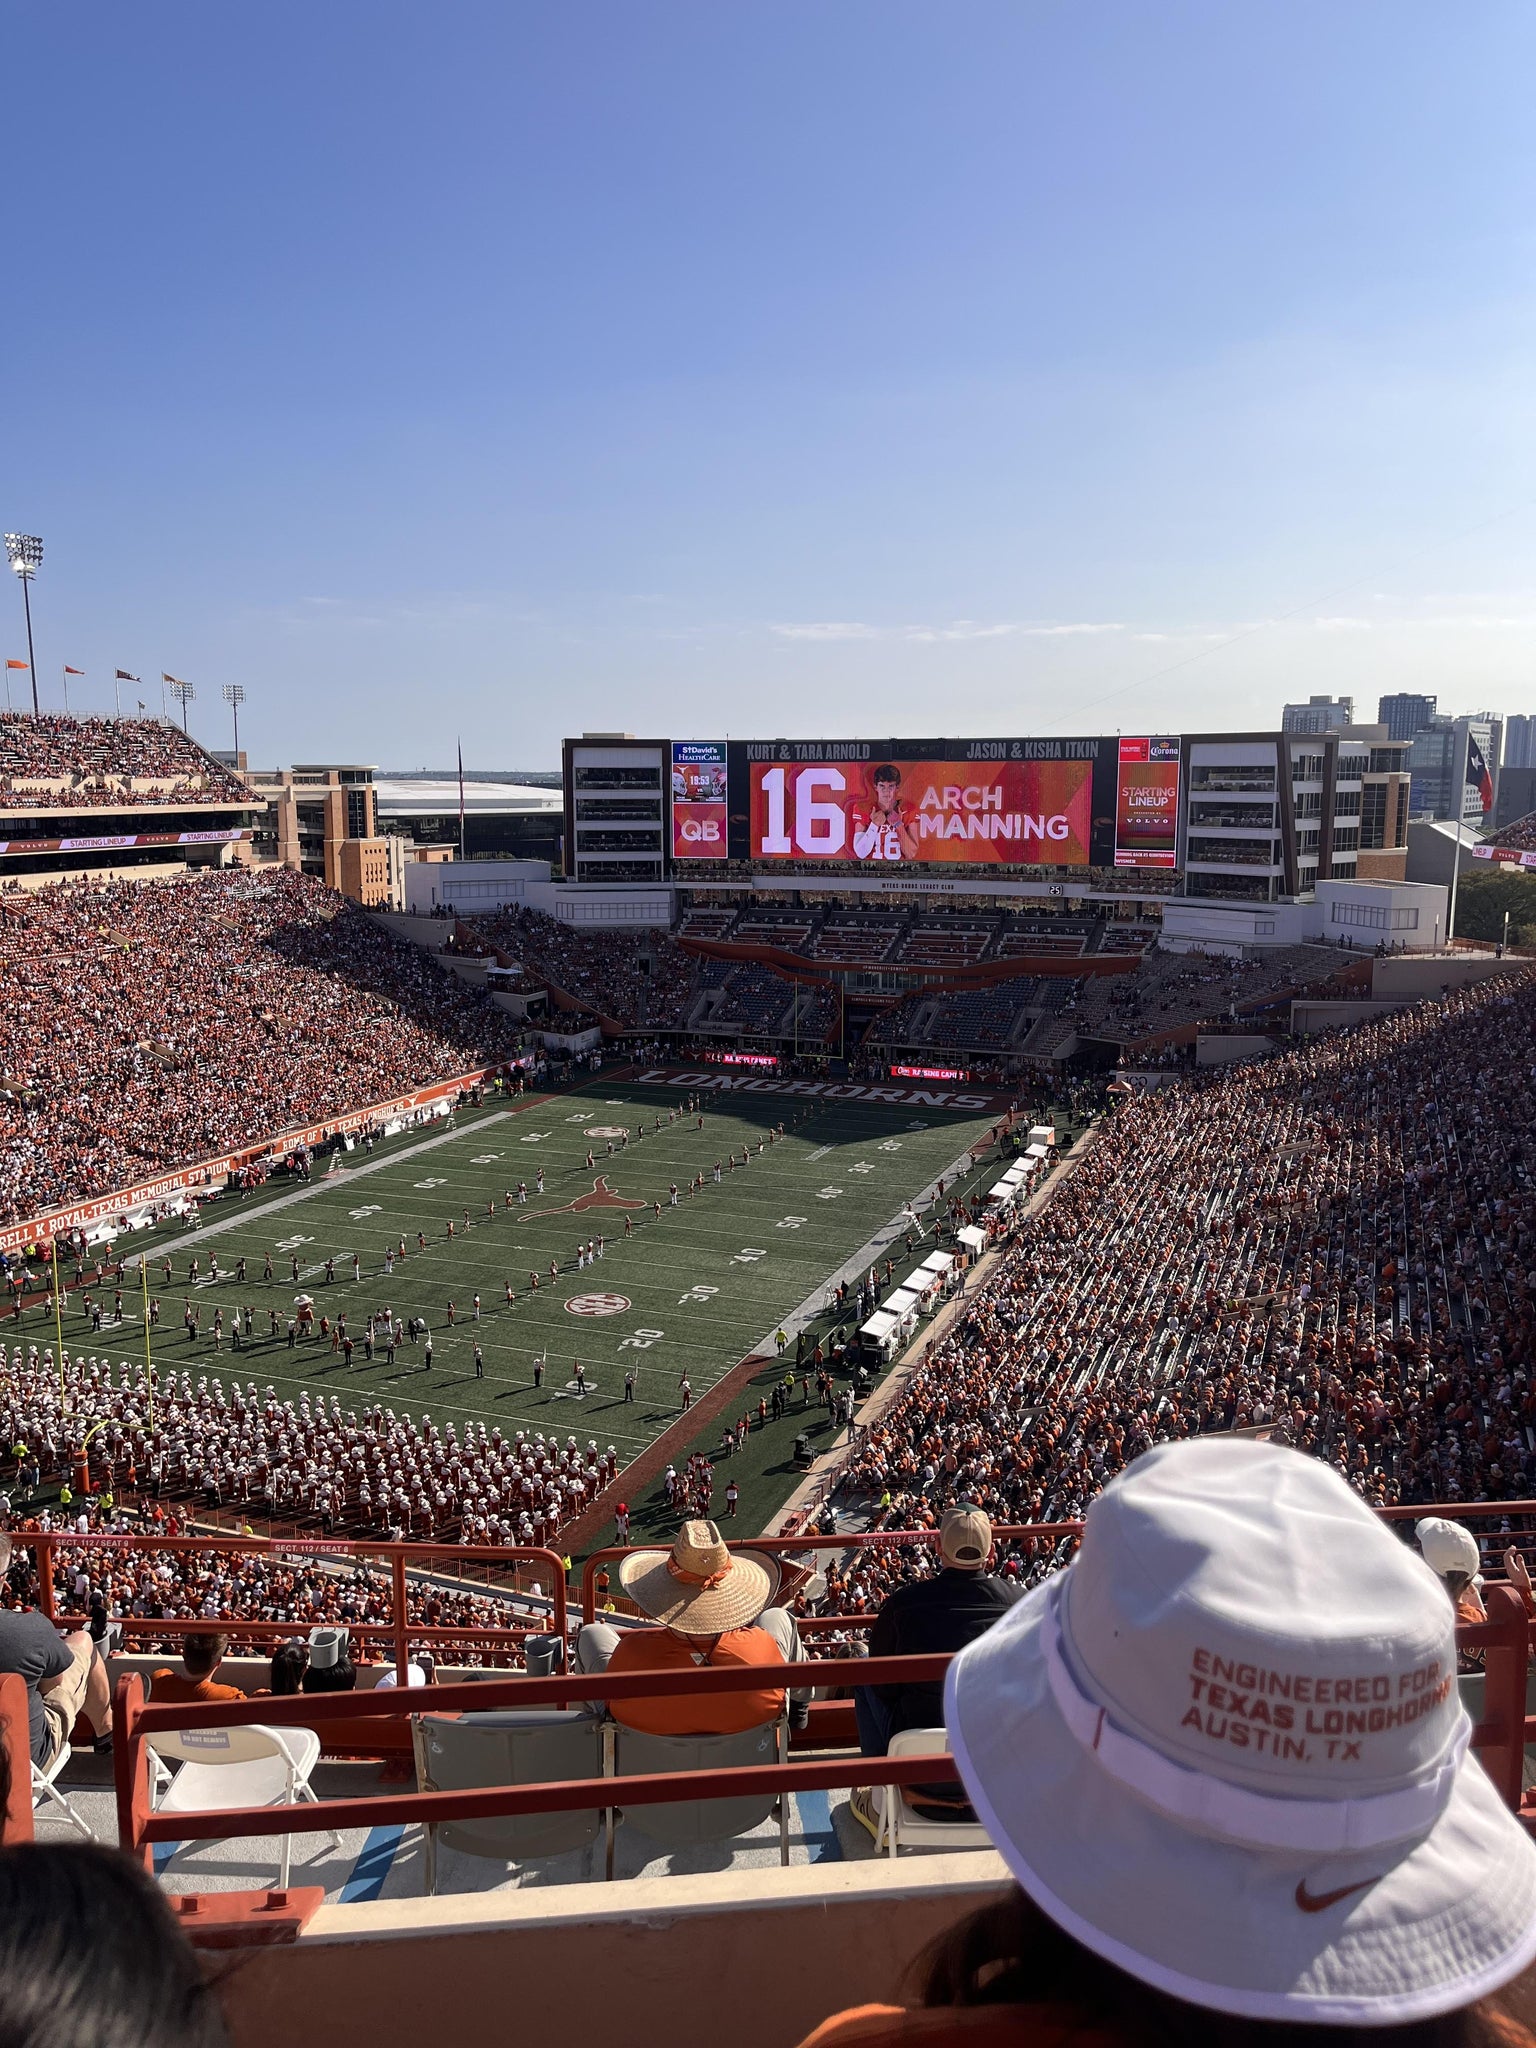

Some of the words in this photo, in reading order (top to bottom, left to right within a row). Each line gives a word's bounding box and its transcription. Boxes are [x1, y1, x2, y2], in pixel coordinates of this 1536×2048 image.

[747, 744, 776, 760] KURT
[779, 744, 791, 760] &
[794, 744, 823, 760] TARA
[825, 743, 870, 760] ARNOLD
[966, 742, 1007, 760] JASON
[1010, 742, 1023, 759] &
[1025, 741, 1062, 759] KISHA
[1065, 740, 1099, 758] ITKIN
[1150, 747, 1179, 757] Corona
[690, 775, 710, 786] 19:53
[919, 786, 1003, 810] ARCH
[1121, 786, 1176, 797] STARTING
[1128, 796, 1169, 807] LINEUP
[761, 768, 846, 854] 16
[681, 820, 720, 841] QB
[919, 814, 1069, 840] MANNING
[70, 838, 103, 848] STARTING
[103, 837, 127, 846] LINEUP
[187, 833, 213, 841] STARTING
[872, 832, 902, 860] 16
[1049, 885, 1061, 895] 25
[912, 1069, 940, 1078] RASING
[630, 1069, 994, 1109] LONGHORNS
[282, 1134, 306, 1151] HOME
[307, 1130, 319, 1143] OF
[337, 1115, 361, 1133] TEXAS
[35, 1222, 46, 1238] K
[49, 1194, 129, 1233] ROYAL-TEXAS
[131, 1175, 186, 1204] MEMORIAL
[188, 1159, 231, 1184] STADIUM
[776, 1216, 808, 1229] 50
[734, 1248, 767, 1263] 40
[681, 1285, 720, 1302] 30
[621, 1328, 665, 1348] 20
[55, 1538, 79, 1547] SECT.
[81, 1538, 95, 1547] 112
[100, 1539, 122, 1547] SEAT
[124, 1540, 129, 1548] 9
[275, 1544, 298, 1552] SECT.
[320, 1545, 342, 1553] SEAT
[343, 1545, 349, 1553] 8
[862, 1537, 886, 1546] SECT.
[888, 1536, 901, 1544] 112
[907, 1535, 929, 1543] SEAT
[1192, 1646, 1390, 1704] ENGINEERED
[1400, 1659, 1441, 1698] FOR
[1189, 1673, 1294, 1730] TEXAS
[1180, 1705, 1312, 1762] AUSTIN,
[1323, 1739, 1363, 1761] TX
